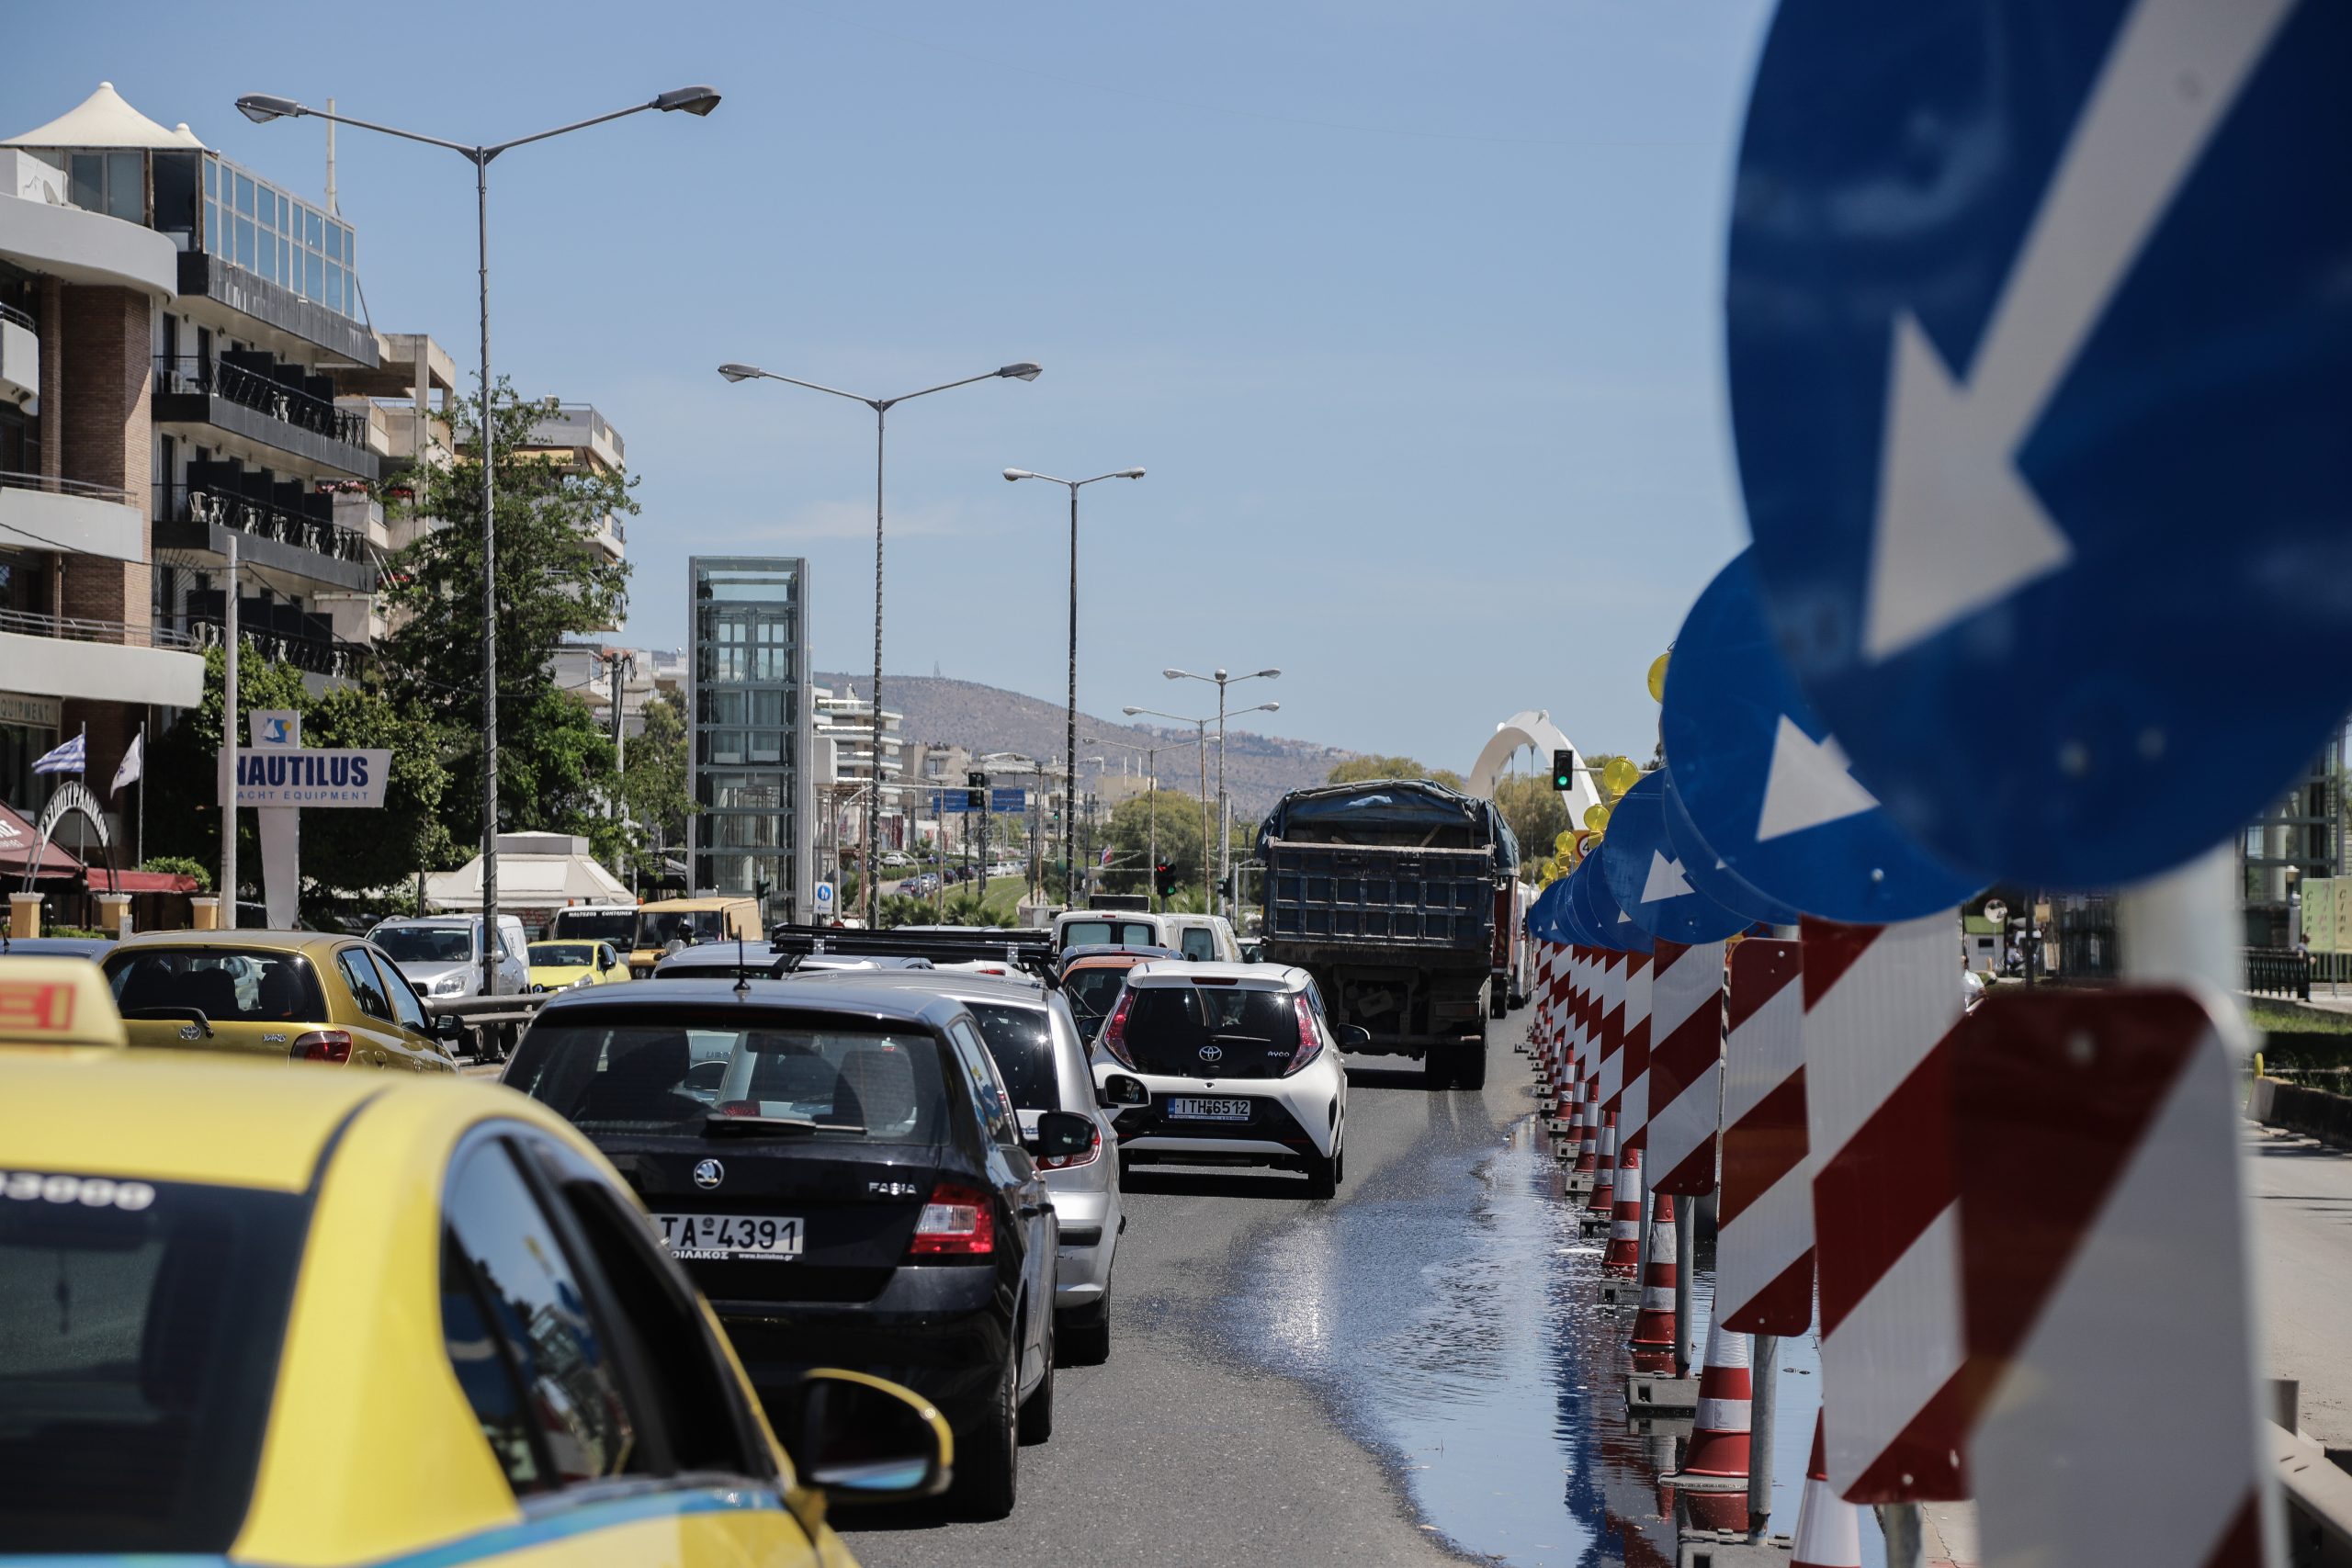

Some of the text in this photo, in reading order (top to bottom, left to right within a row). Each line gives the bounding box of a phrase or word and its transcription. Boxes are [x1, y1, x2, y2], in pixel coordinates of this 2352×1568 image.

[0, 699, 51, 721] QUIPMENT
[237, 791, 368, 800] ACHT EQUIPMENT
[869, 1182, 917, 1195] FABIA
[661, 1216, 797, 1251] TA-4391
[671, 1250, 729, 1260] ΟΙΛΑΚΟΣ
